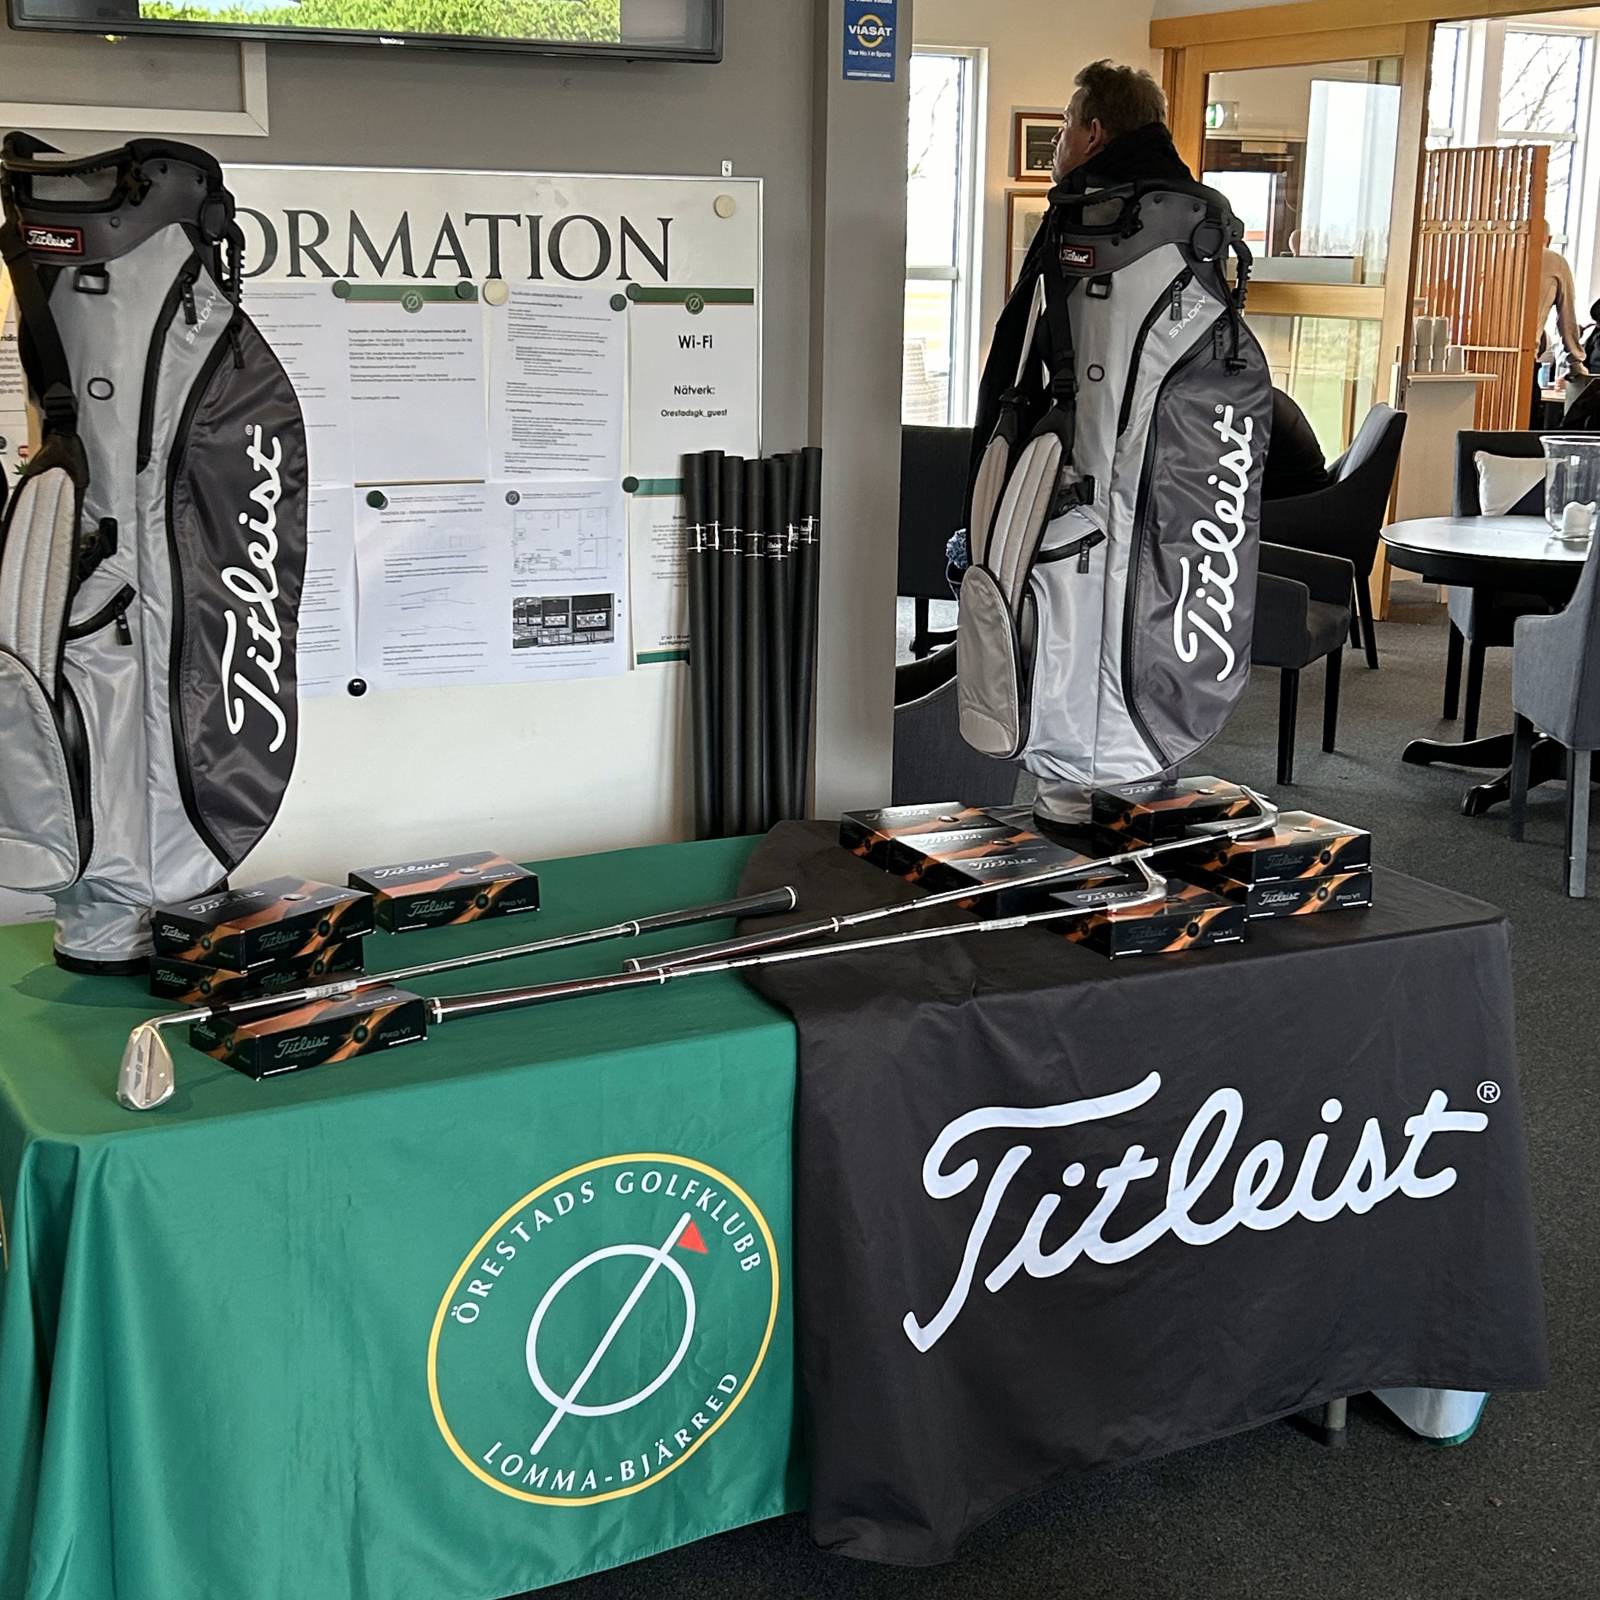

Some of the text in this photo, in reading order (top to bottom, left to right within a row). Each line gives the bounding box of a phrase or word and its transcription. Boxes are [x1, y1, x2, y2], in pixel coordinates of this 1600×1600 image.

[848, 25, 892, 36] VIASAT
[26, 230, 75, 248] Titleist
[1168, 296, 1207, 338] STADRY
[678, 334, 713, 349] Wi-Fi
[673, 385, 716, 395] Nätverk:
[660, 409, 728, 418] Orestadsgk_guest
[373, 862, 449, 879] Titleist
[1258, 891, 1300, 906] Titleist
[407, 899, 456, 918] Titleist
[160, 924, 190, 941] Titleist
[257, 930, 300, 952] Titleist
[274, 1035, 331, 1059] Titleist
[903, 1071, 1489, 1353] Titleist
[450, 1170, 761, 1325] ÖRESTADS GOLFKLUBB
[482, 1373, 738, 1492] LOMMA-BJÄRRED
